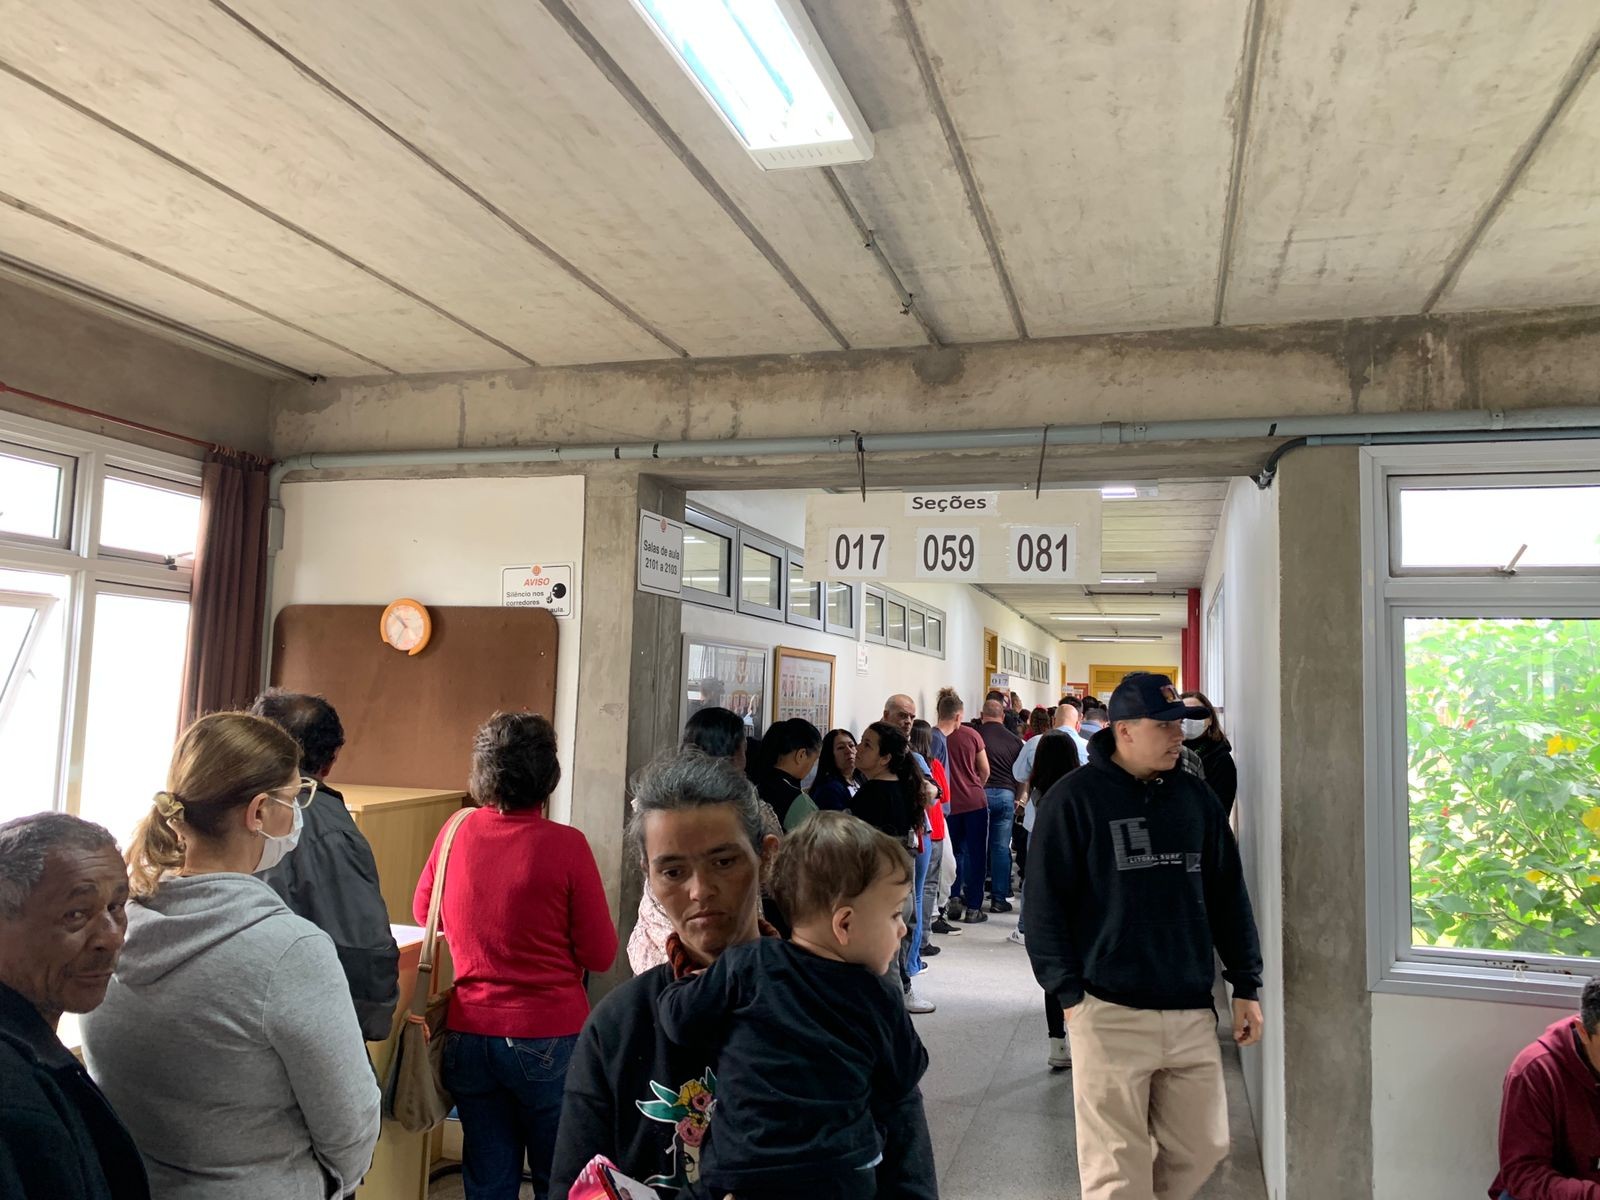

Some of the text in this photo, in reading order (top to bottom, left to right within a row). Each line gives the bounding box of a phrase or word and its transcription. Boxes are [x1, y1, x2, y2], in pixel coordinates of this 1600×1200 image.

[911, 495, 987, 512] Seções
[643, 539, 680, 560] Salas de aula
[835, 533, 1068, 572] 017 059 081
[645, 557, 659, 571] 2101
[660, 563, 664, 572] a
[523, 577, 550, 587] AVISO
[506, 590, 531, 598] Silêncio
